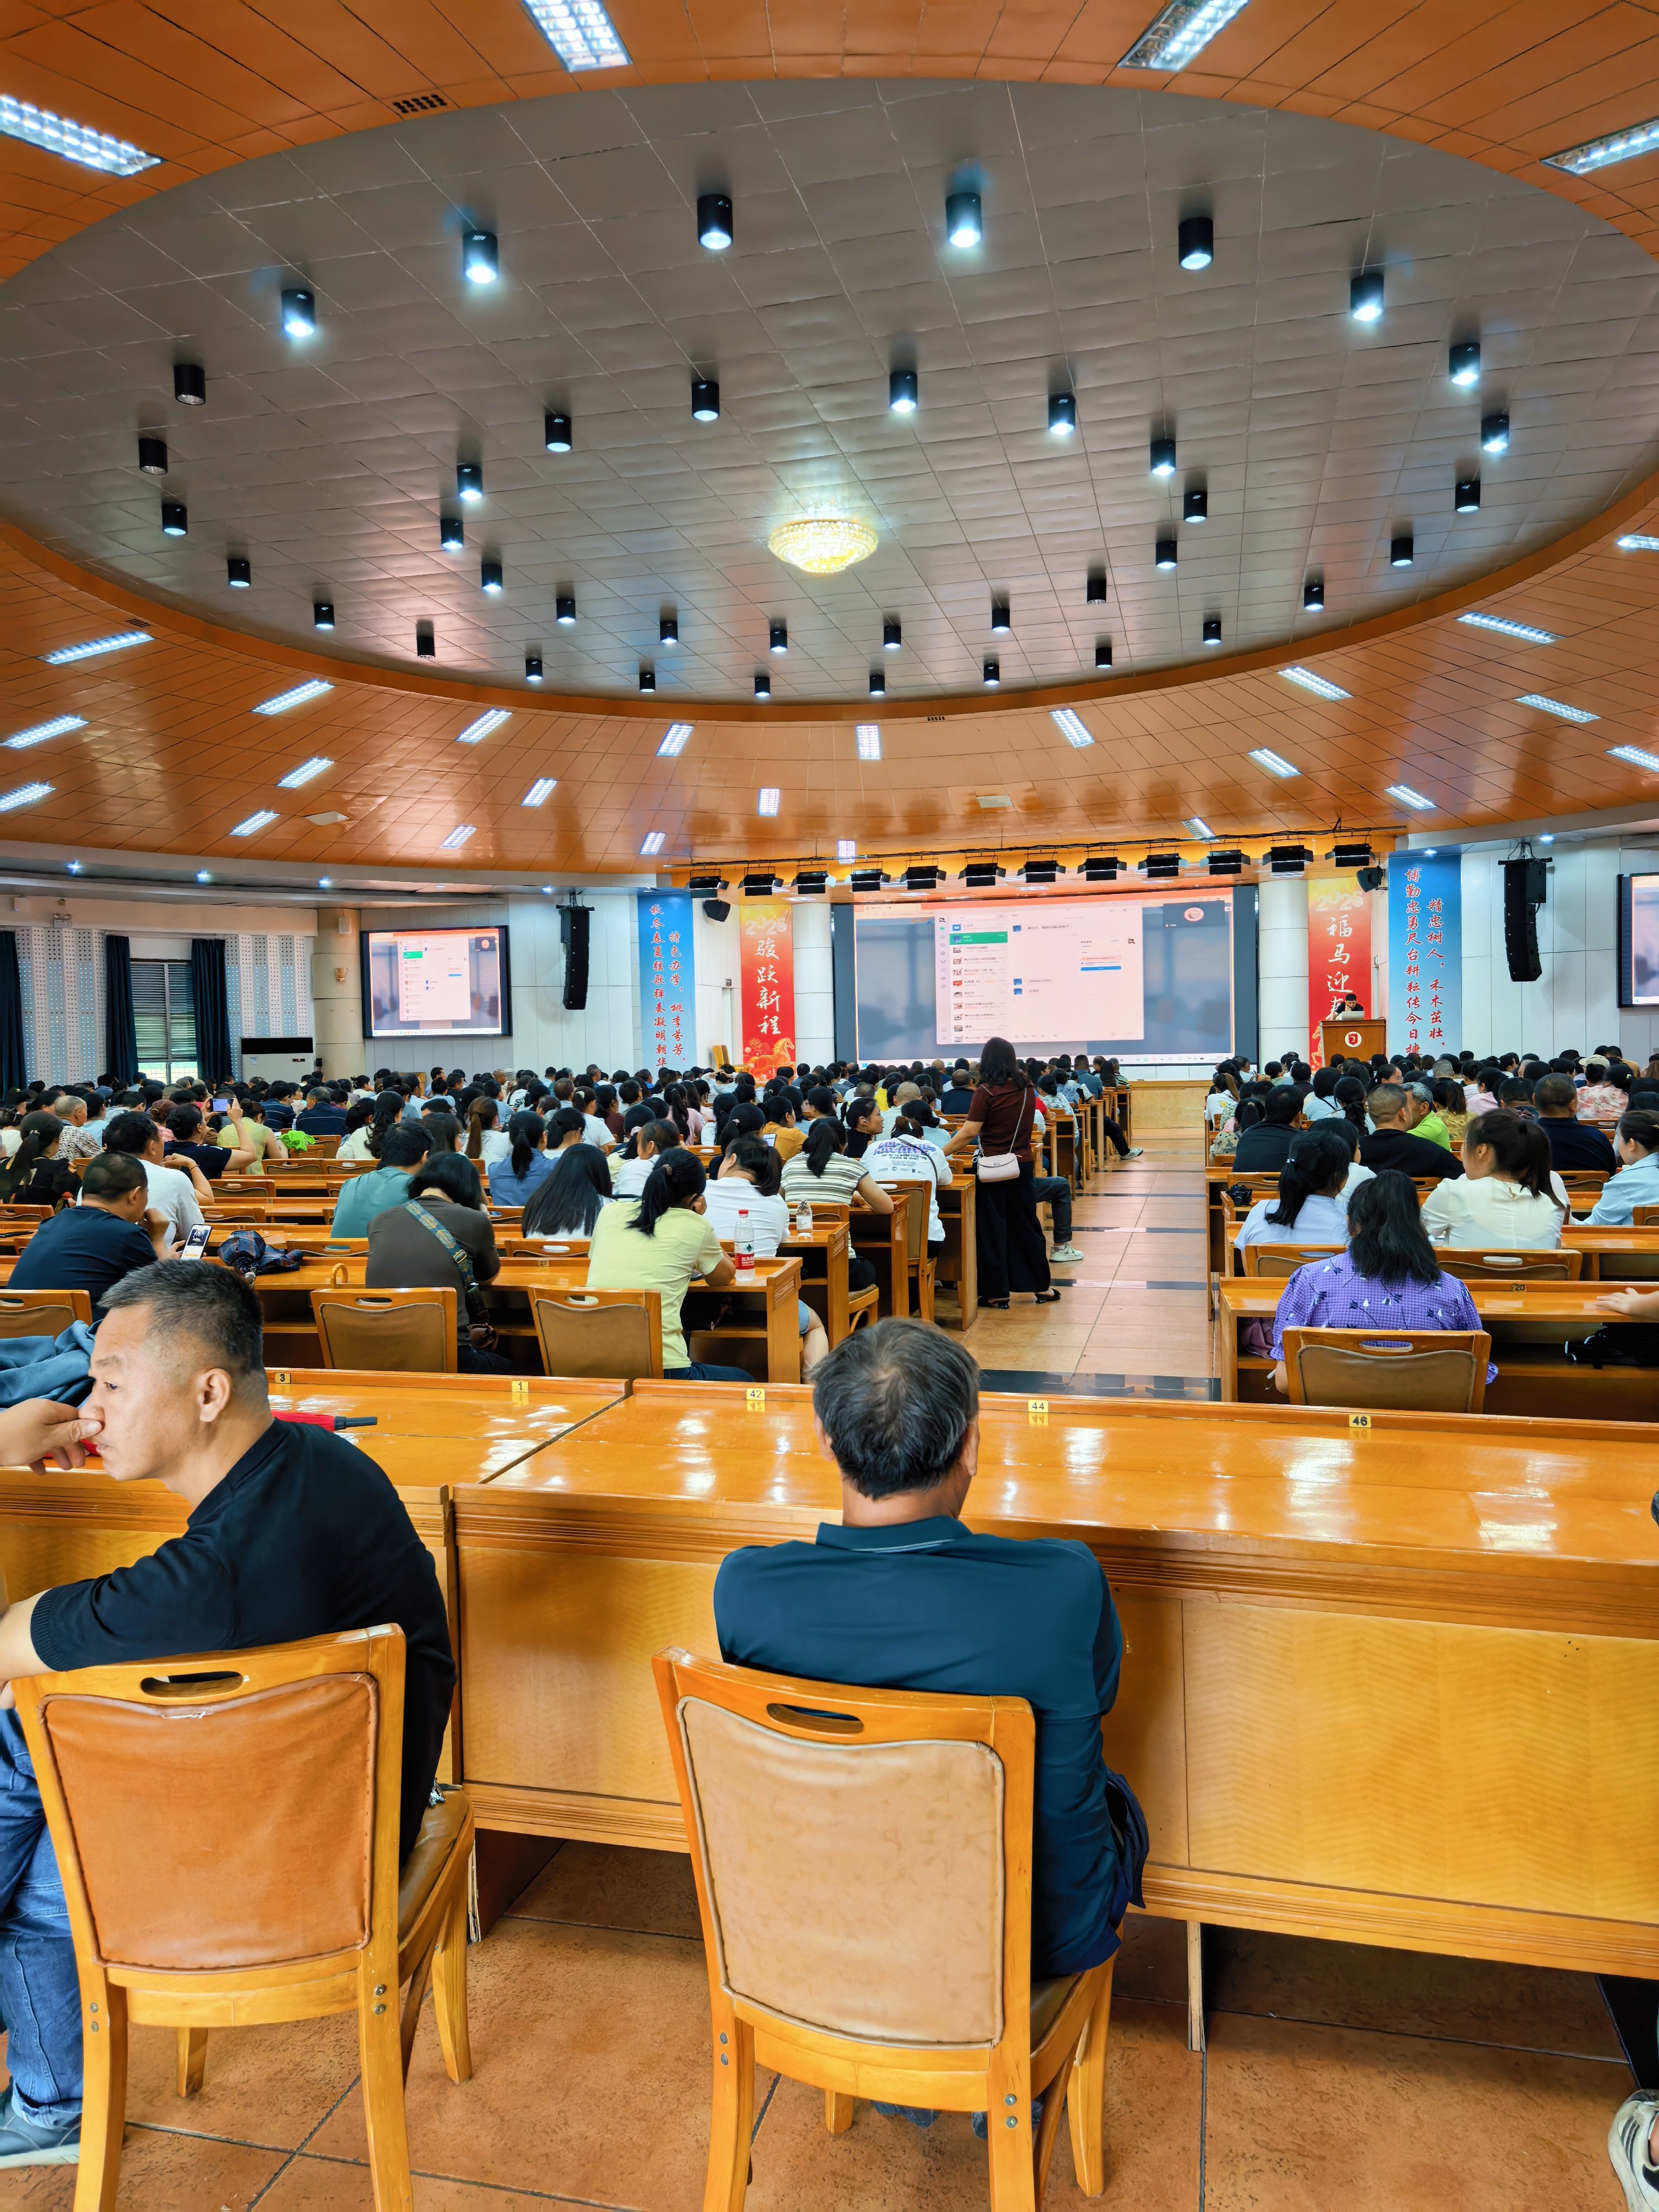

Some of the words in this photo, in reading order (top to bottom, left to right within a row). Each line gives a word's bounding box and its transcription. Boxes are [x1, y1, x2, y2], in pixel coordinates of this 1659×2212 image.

[1316, 891, 1363, 912] 2026
[745, 916, 787, 935] 2026
[754, 938, 781, 1034] 骏跃新程
[280, 1373, 286, 1382] 3
[518, 1381, 523, 1391] 1
[750, 1390, 762, 1398] 42
[1032, 1401, 1045, 1411] 44
[1352, 1416, 1367, 1426] 46
